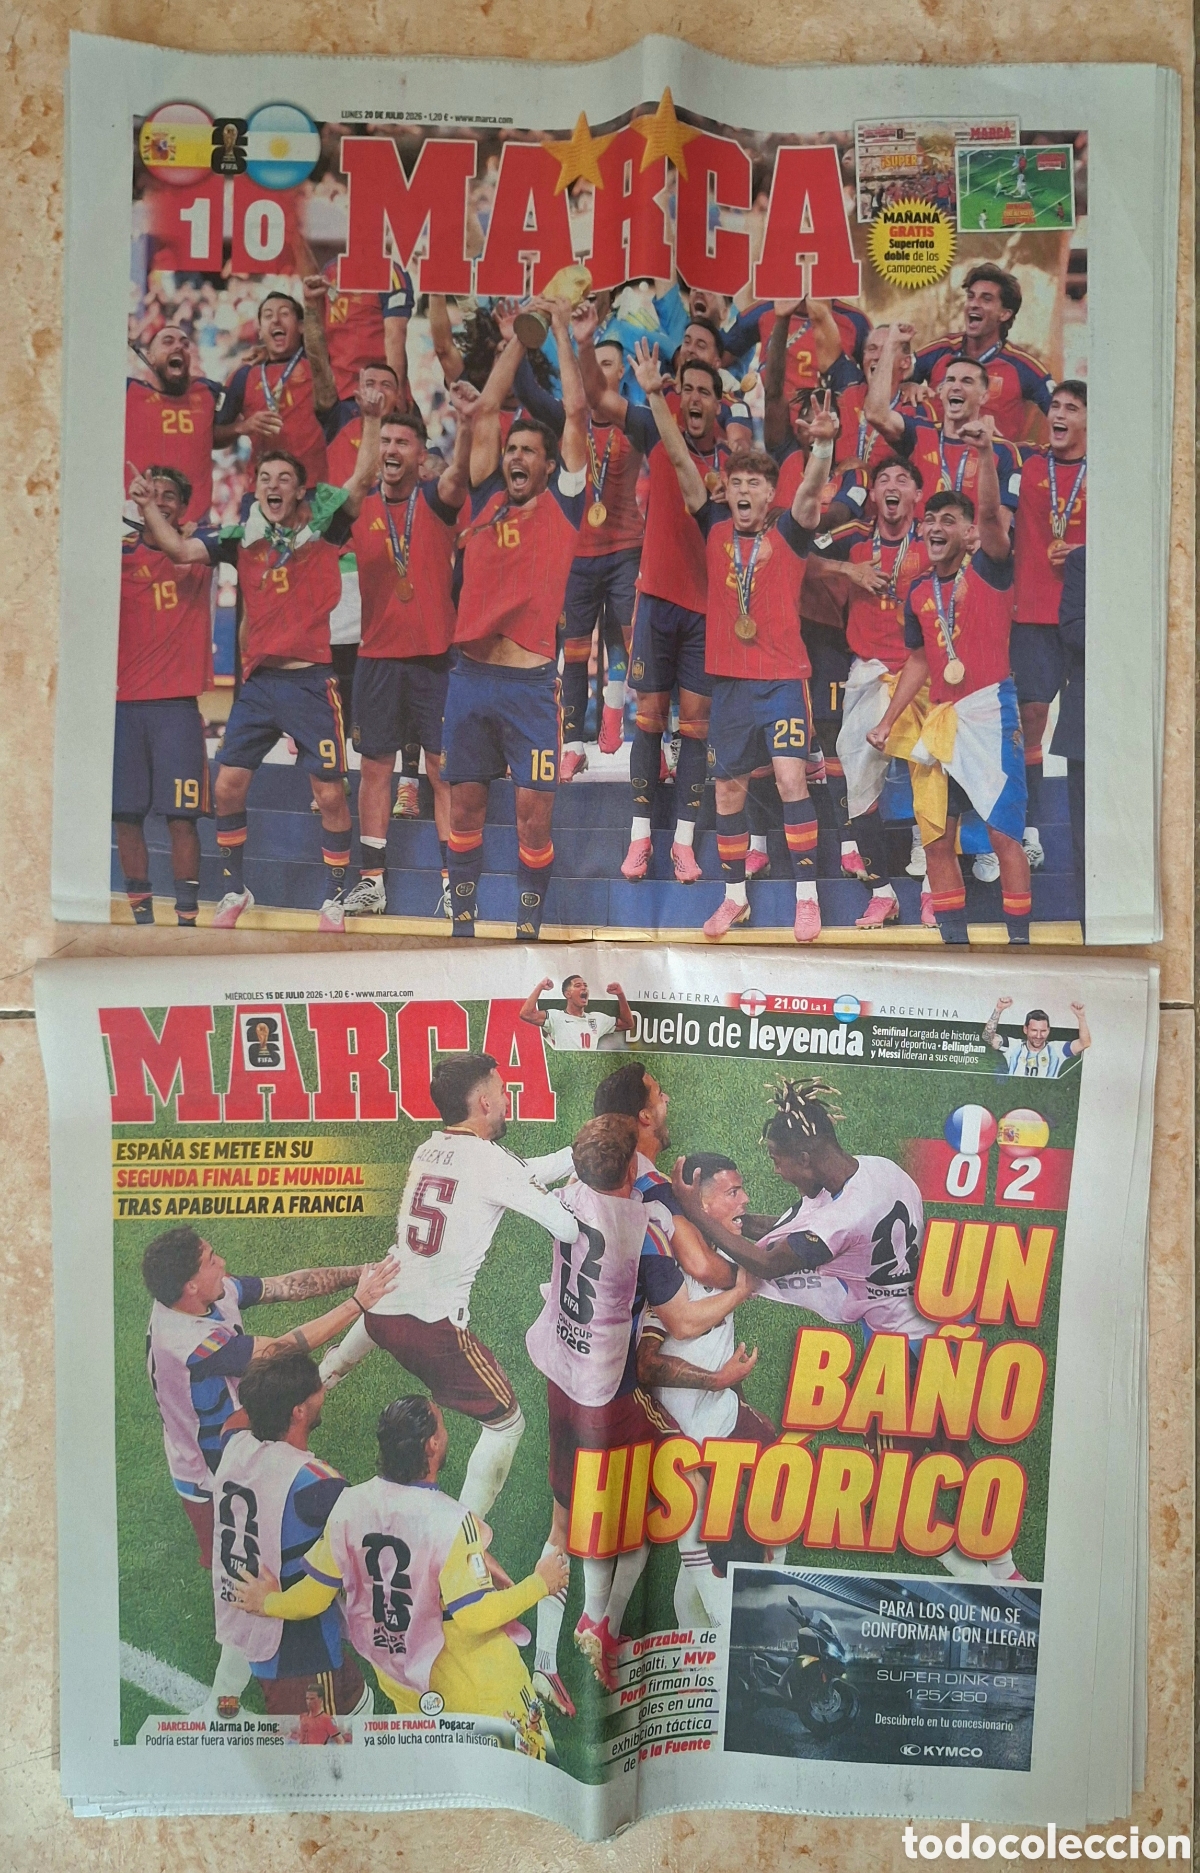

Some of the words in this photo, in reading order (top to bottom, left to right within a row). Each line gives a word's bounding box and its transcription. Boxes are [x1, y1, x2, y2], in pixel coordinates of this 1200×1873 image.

[341, 110, 363, 119] LUNES
[364, 111, 374, 120] 20
[375, 111, 384, 120] DE
[385, 111, 404, 120] JULIO
[406, 112, 422, 120] 2026
[429, 112, 442, 122] 1,20
[444, 113, 449, 122] €
[455, 114, 514, 124] www.marca.com
[337, 118, 862, 300] MARCA
[884, 210, 940, 224] MAÑANA
[179, 197, 211, 259] 1
[244, 199, 285, 261] 0
[889, 226, 934, 238] GRATIS
[889, 239, 934, 250] Superfoto
[884, 251, 910, 260] doble
[912, 251, 924, 260] de
[926, 251, 940, 261] los
[886, 264, 936, 274] campeones
[161, 408, 194, 435] 26
[495, 519, 520, 548] 16
[272, 566, 289, 594] 9
[152, 581, 178, 610] 19
[772, 719, 805, 749] 25
[318, 740, 336, 769] 9
[531, 749, 555, 781] 16
[174, 778, 199, 808] 19
[225, 990, 264, 1000] MIÉRCOLES
[265, 992, 274, 1000] 15
[275, 992, 284, 1000] DE
[285, 991, 304, 999] JULIO
[306, 990, 324, 999] 2026
[330, 990, 343, 999] 1,20
[344, 990, 350, 998] €
[355, 990, 414, 998] www.marca.com
[638, 990, 720, 1004] INGLATERRA
[773, 998, 809, 1010] 21.00
[810, 1002, 820, 1010] La
[822, 1004, 827, 1012] 1
[880, 1006, 959, 1019] ARGENTINA
[580, 1032, 591, 1049] 10
[625, 1010, 700, 1046] Duelo
[708, 1015, 742, 1048] de
[749, 1017, 864, 1057] leyenda
[872, 1025, 909, 1038] Semifinal
[909, 1028, 939, 1040] cargada
[940, 1030, 950, 1040] de
[951, 1030, 980, 1042] historia
[872, 1038, 893, 1048] social
[894, 1040, 899, 1050] y
[900, 1038, 936, 1051] deportiva
[942, 1042, 986, 1054] Bellingham
[98, 998, 557, 1124] MARCA
[870, 1051, 876, 1060] y
[878, 1048, 900, 1060] Messi
[902, 1050, 928, 1061] lideran
[928, 1053, 934, 1061] a
[934, 1054, 947, 1062] sus
[948, 1054, 979, 1066] equipos
[116, 1138, 188, 1162] ESPAÑA
[189, 1141, 211, 1160] SE
[214, 1141, 261, 1160] METE
[264, 1140, 287, 1159] EN
[290, 1140, 314, 1158] SU
[116, 1168, 199, 1188] SEGUNDA
[203, 1168, 254, 1188] FINAL
[257, 1167, 279, 1186] DE
[282, 1166, 365, 1186] MUNDIAL
[946, 1152, 982, 1198] 0
[1002, 1156, 1042, 1202] 2
[118, 1197, 162, 1216] TRAS
[164, 1196, 269, 1216] APABULLAR
[272, 1195, 285, 1214] A
[289, 1194, 365, 1214] FRANCIA
[406, 1173, 459, 1258] 5
[914, 1218, 1059, 1328] UN
[563, 1292, 579, 1315] FIFA
[574, 1326, 592, 1340] CUP
[781, 1323, 1048, 1445] BAÑO
[566, 1430, 1029, 1560] HISTÓRICO
[879, 1600, 915, 1618] PARA
[918, 1603, 945, 1619] LOS
[949, 1604, 976, 1622] QUE
[981, 1606, 1000, 1623] NO
[1004, 1608, 1021, 1624] SE
[632, 1630, 696, 1656] Oyarzabal,
[700, 1630, 717, 1644] de
[861, 1622, 949, 1642] CONFORMAN
[952, 1625, 980, 1644] CON
[985, 1628, 1036, 1648] LLEGAR
[628, 1656, 668, 1682] penalti,
[672, 1656, 680, 1669] y
[684, 1652, 717, 1666] MVP
[648, 1677, 690, 1694] firman
[694, 1674, 715, 1687] los
[876, 1669, 941, 1684] SUPER
[944, 1674, 989, 1687] DINK
[993, 1675, 1018, 1688] GT
[668, 1698, 684, 1711] en
[687, 1697, 713, 1708] una
[906, 1688, 988, 1703] 125/350
[160, 1722, 207, 1731] BARCELONA
[210, 1721, 242, 1732] Alarma
[244, 1722, 255, 1732] De
[257, 1721, 280, 1733] Jong:
[368, 1721, 390, 1731] TOUR
[391, 1720, 400, 1730] DE
[402, 1720, 436, 1730] FRANCIA
[440, 1720, 475, 1731] Pogacar
[666, 1717, 712, 1733] táctica
[875, 1712, 925, 1727] Descúbrelo
[927, 1718, 938, 1727] en
[940, 1716, 950, 1728] tu
[952, 1718, 1014, 1732] concesionario
[146, 1734, 174, 1746] Podría
[176, 1736, 198, 1746] estar
[200, 1734, 224, 1746] fuera
[226, 1735, 254, 1746] varios
[256, 1736, 284, 1746] meses
[364, 1736, 375, 1748] ya
[377, 1734, 396, 1746] sólo
[398, 1733, 422, 1744] lucha
[424, 1734, 454, 1744] contra
[455, 1732, 464, 1744] la
[466, 1733, 498, 1748] historia
[624, 1758, 636, 1773] de
[650, 1744, 663, 1758] la
[665, 1738, 711, 1754] Fuente
[923, 1746, 983, 1758] KYMCO
